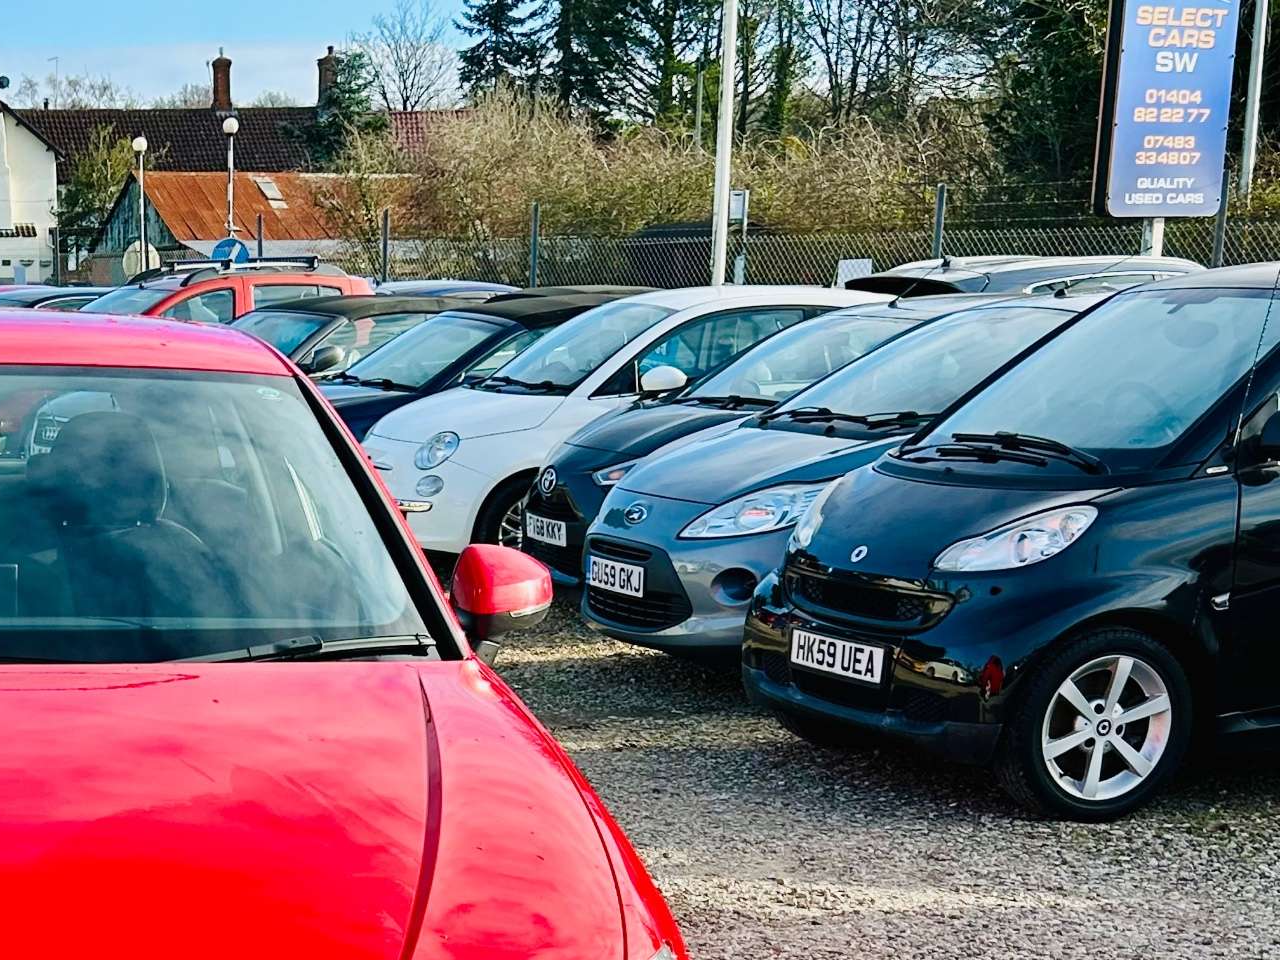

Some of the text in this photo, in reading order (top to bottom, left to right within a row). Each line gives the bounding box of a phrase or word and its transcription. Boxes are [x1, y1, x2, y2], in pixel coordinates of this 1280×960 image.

[1136, 6, 1228, 27] SELECT
[1148, 28, 1216, 49] CARS
[1155, 51, 1198, 73] SW
[1145, 88, 1202, 105] 01404
[1144, 135, 1195, 149] 07483
[1135, 151, 1201, 165] 334807
[1136, 177, 1195, 189] QUALITY
[1124, 193, 1204, 205] USED CARS
[618, 567, 641, 593] GKJ
[796, 633, 874, 679] HK59 UEA
